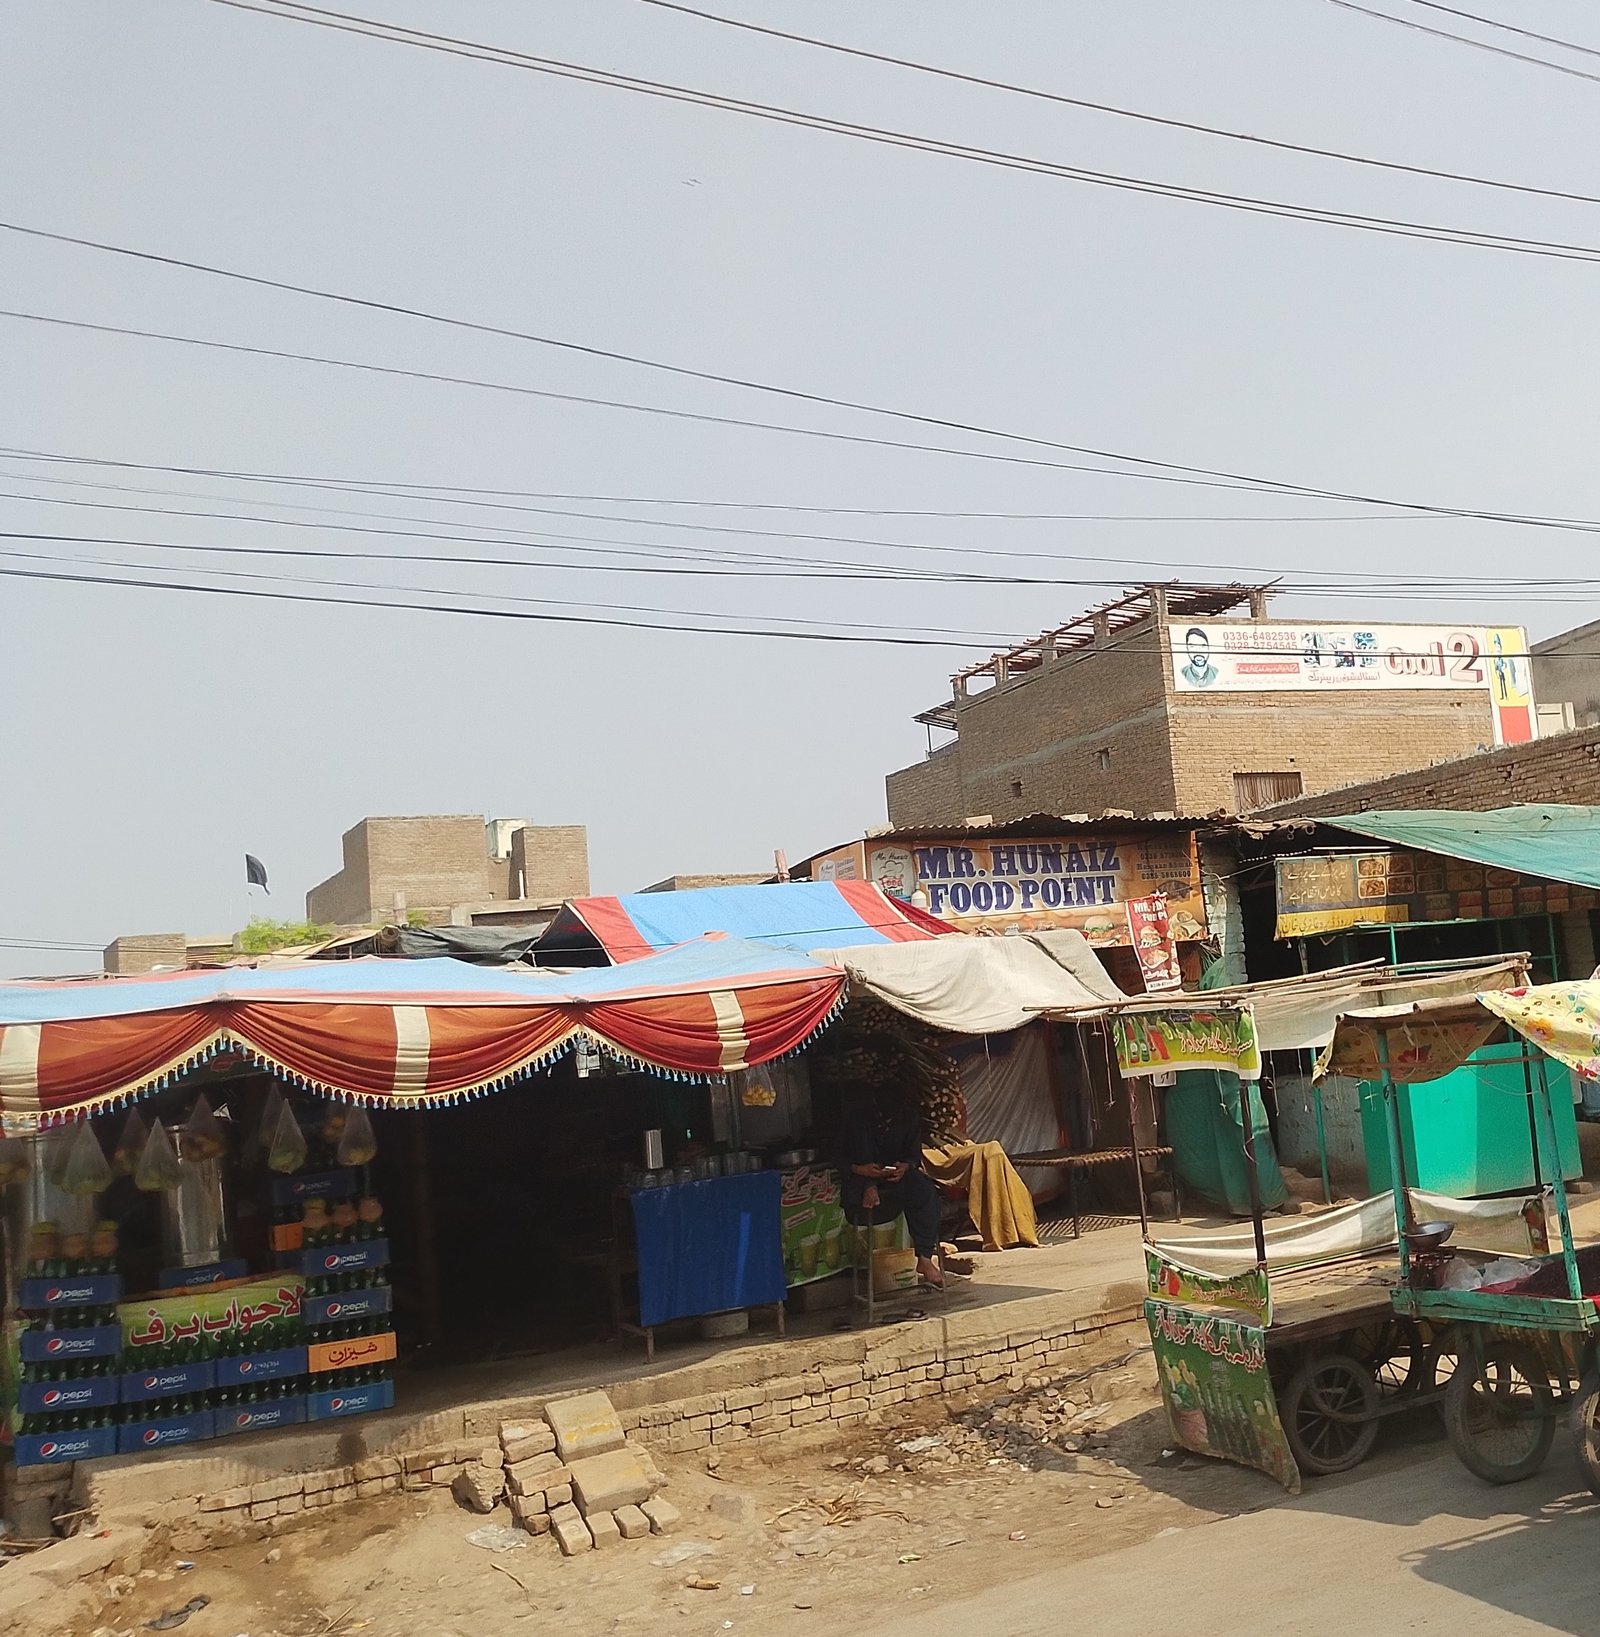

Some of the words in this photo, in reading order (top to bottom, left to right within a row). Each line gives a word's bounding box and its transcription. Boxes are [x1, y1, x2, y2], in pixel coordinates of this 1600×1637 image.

[1223, 631, 1297, 641] 0336-6482536
[1447, 632, 1483, 683] 2
[917, 846, 986, 880] MR.
[991, 841, 1121, 877] HUNAIZ
[927, 881, 1016, 915] FOOD
[1018, 874, 1117, 910] POINT
[338, 1250, 368, 1266] pepsi
[62, 1287, 95, 1301] pepsi
[341, 1300, 370, 1314] pepsi
[130, 1308, 201, 1350] برف
[63, 1338, 96, 1352] pepsi
[328, 1341, 378, 1366] شیزان
[159, 1373, 188, 1389] pepsi
[61, 1388, 93, 1403] pepsi
[252, 1408, 281, 1423] pepsi
[160, 1427, 190, 1442] pepsi
[58, 1439, 90, 1455] pepsi
